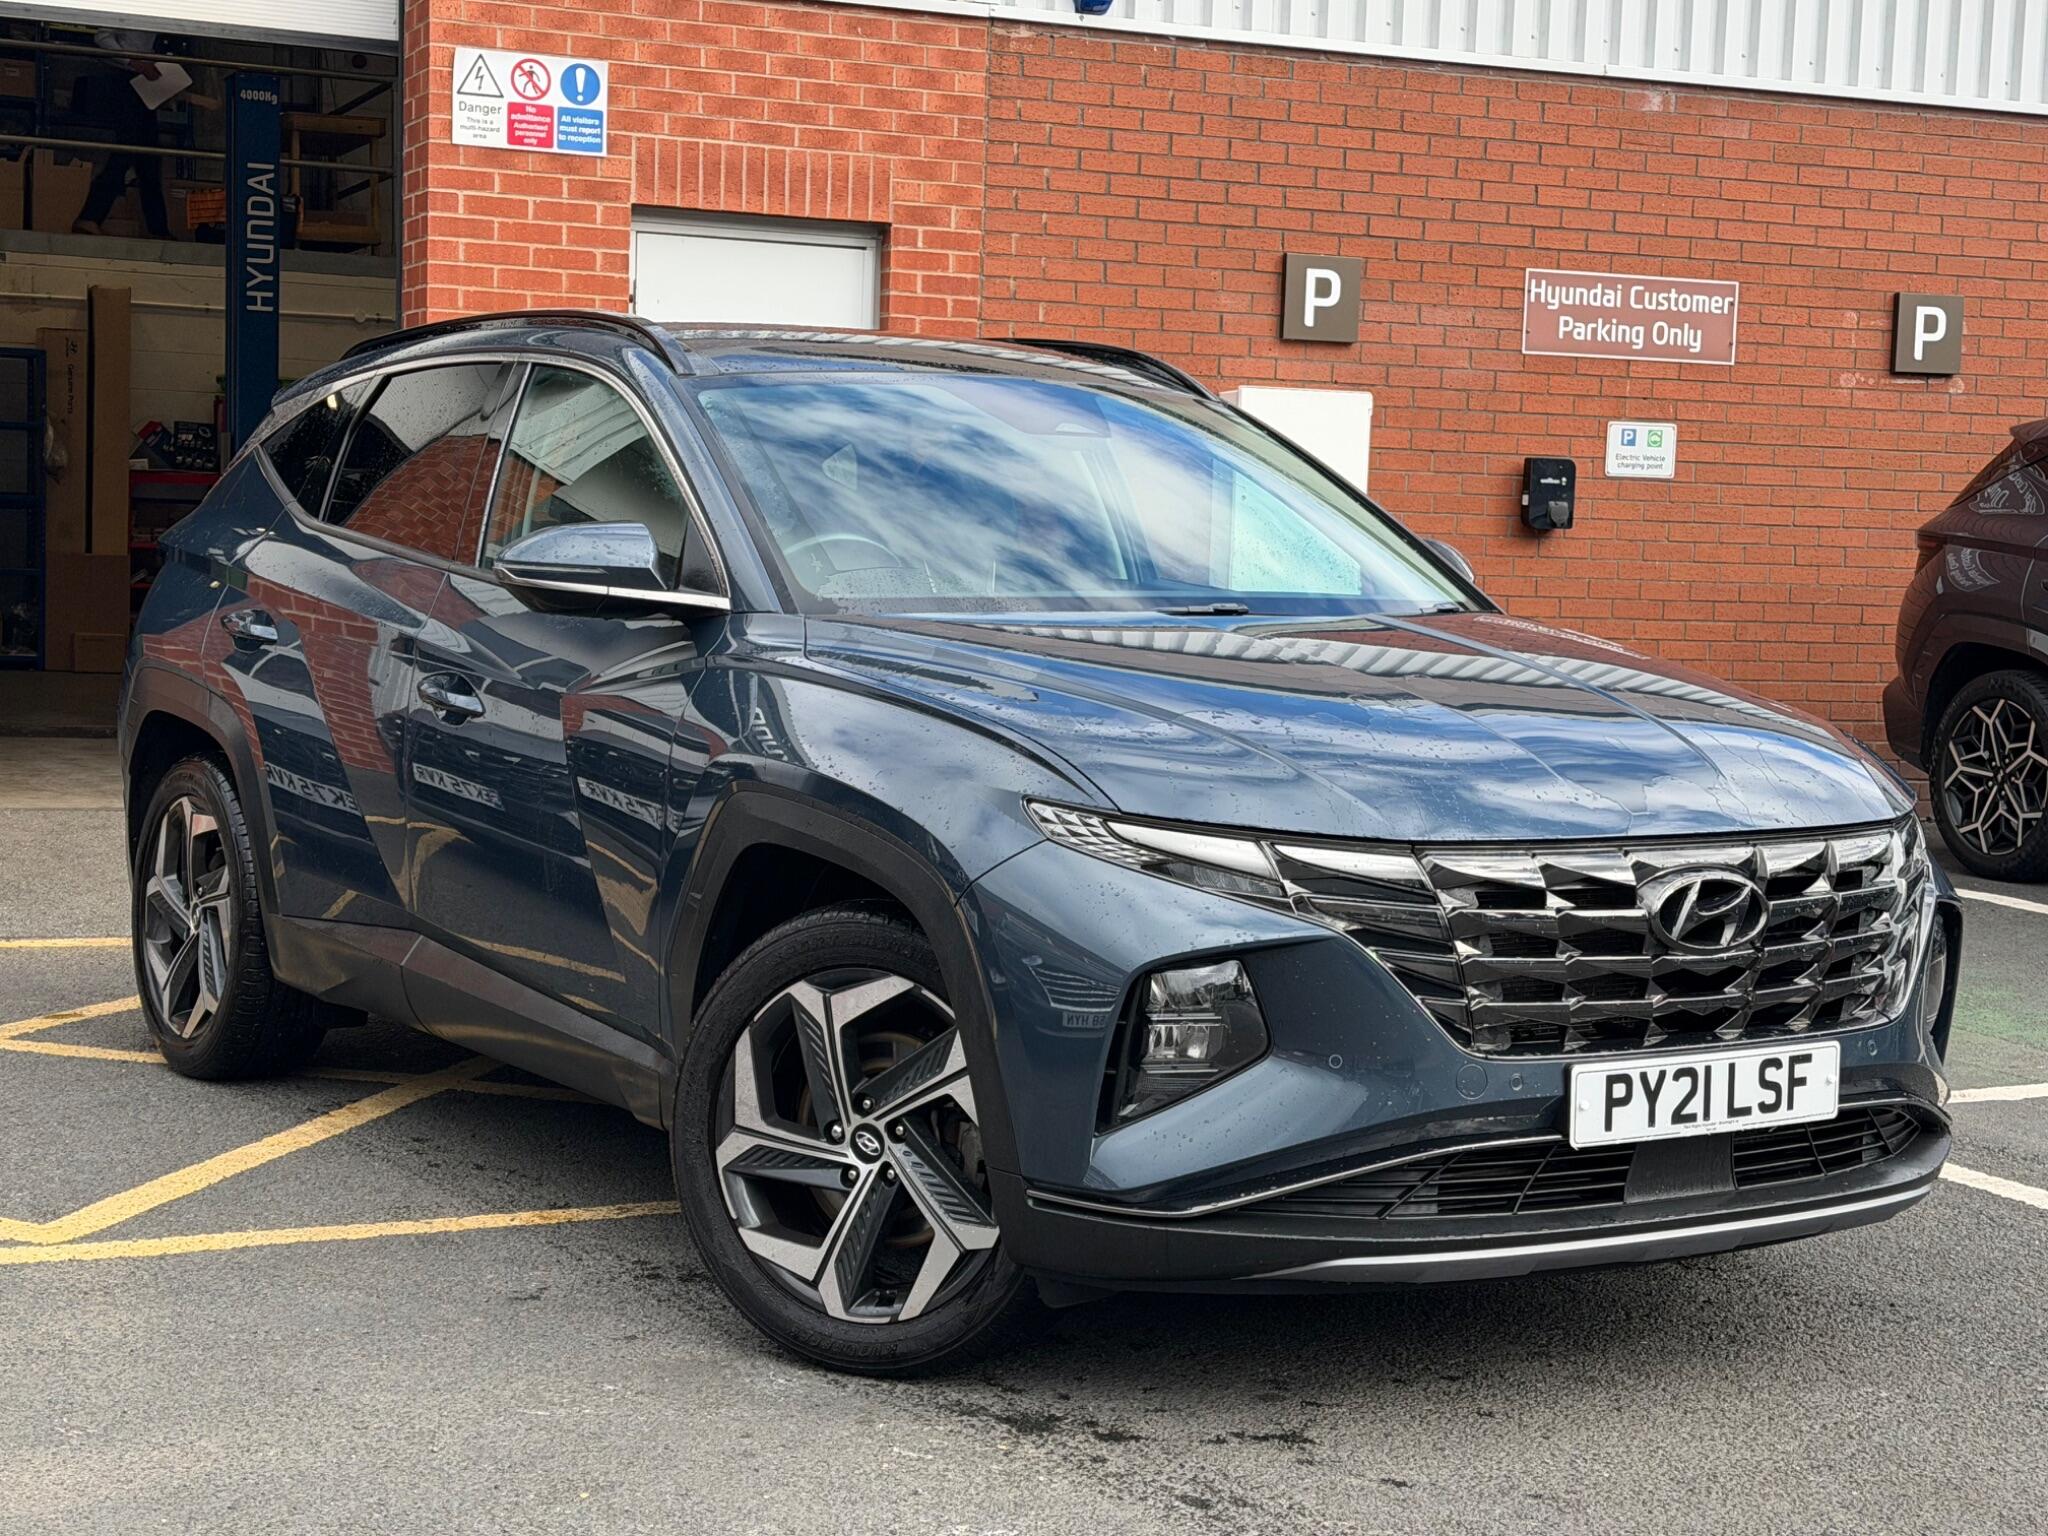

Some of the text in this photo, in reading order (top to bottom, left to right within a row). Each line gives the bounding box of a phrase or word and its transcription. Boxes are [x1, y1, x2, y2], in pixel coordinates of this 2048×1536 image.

[240, 89, 278, 105] 4000Kg
[459, 101, 502, 116] Danger
[525, 105, 537, 113] No
[573, 117, 600, 125] visitors
[579, 127, 601, 135] report
[246, 163, 275, 312] HYUNDAI
[1304, 268, 1341, 327] P
[1530, 279, 1734, 314] Hyundai Customer
[1559, 315, 1702, 352] Parking Only
[1914, 305, 1947, 361] P
[1623, 431, 1633, 445] P
[1615, 453, 1640, 462] Electric
[1617, 462, 1644, 470] charging
[1604, 1053, 1812, 1132] PY21 LSF
